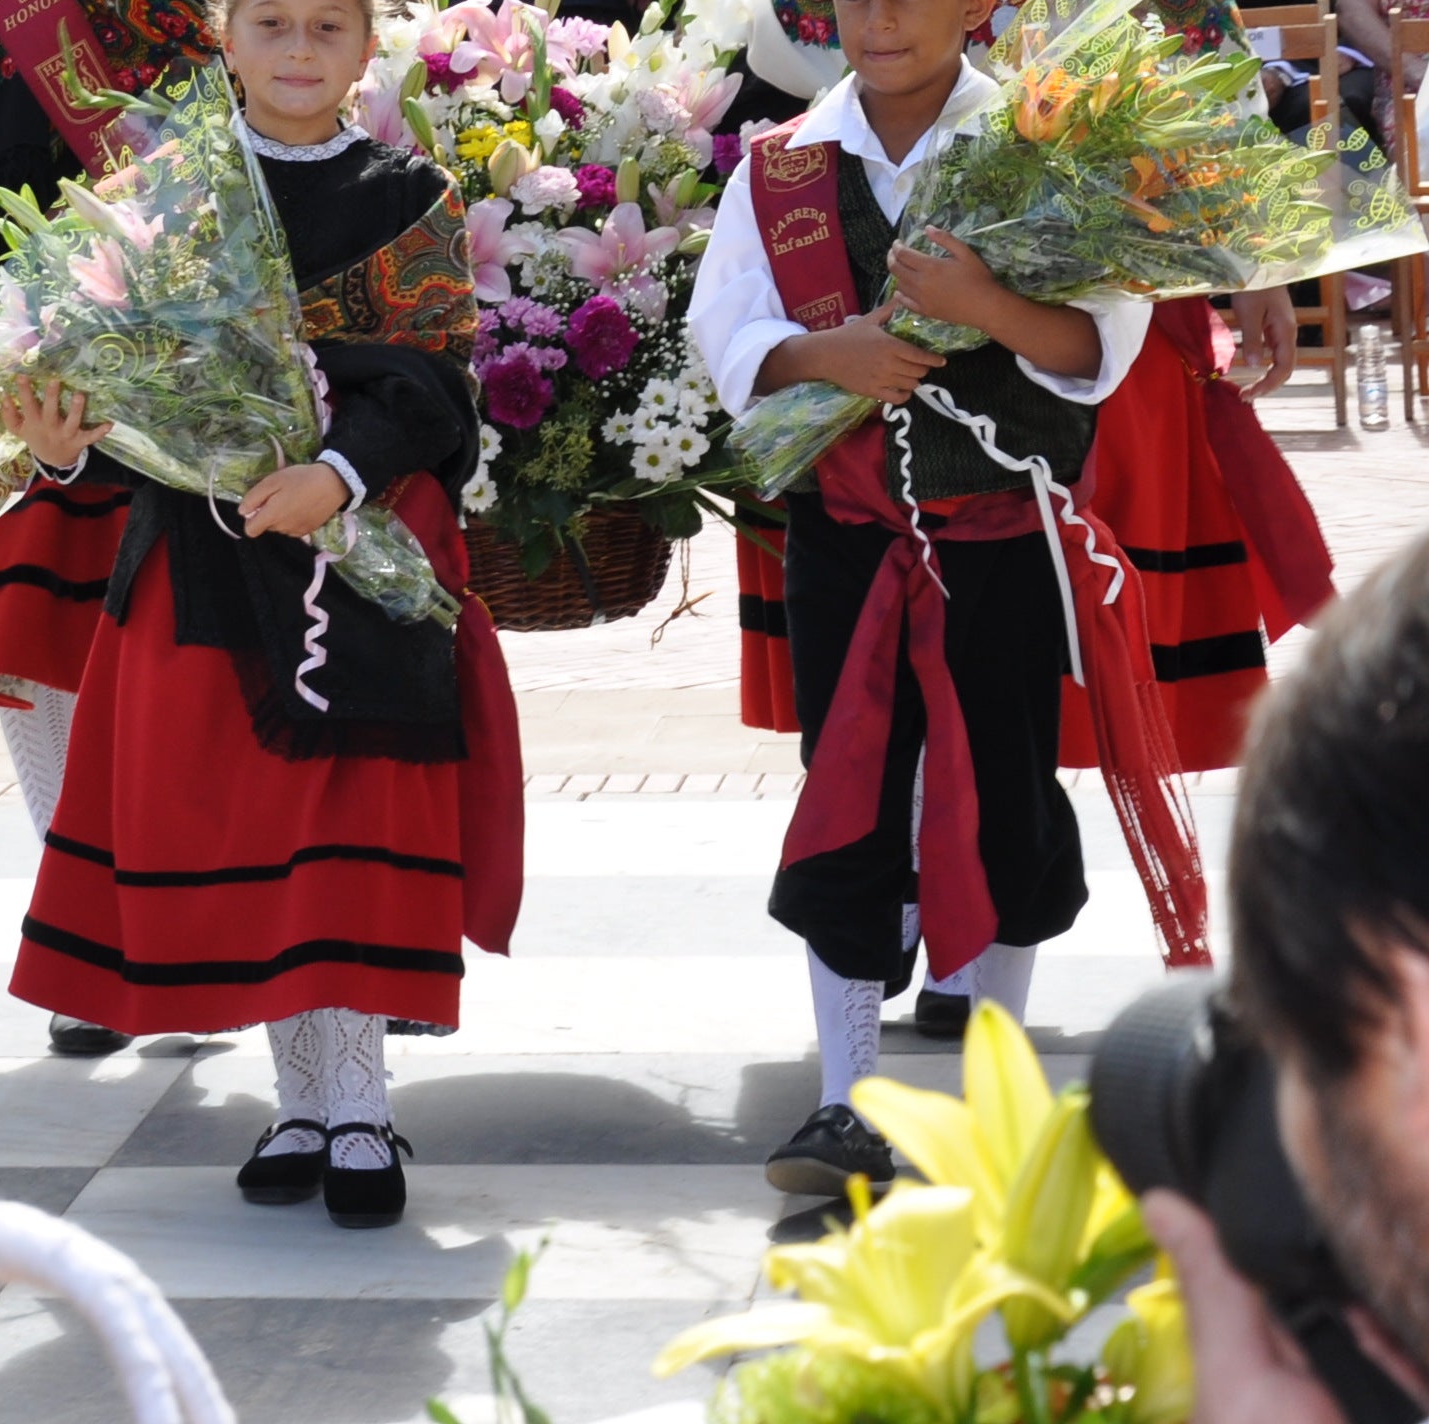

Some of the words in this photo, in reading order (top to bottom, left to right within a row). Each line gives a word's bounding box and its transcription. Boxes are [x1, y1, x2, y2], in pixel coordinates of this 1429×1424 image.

[42, 47, 84, 77] HAO
[769, 207, 828, 241] JARRERO
[772, 225, 830, 256] Infantil
[801, 299, 838, 322] HARO
